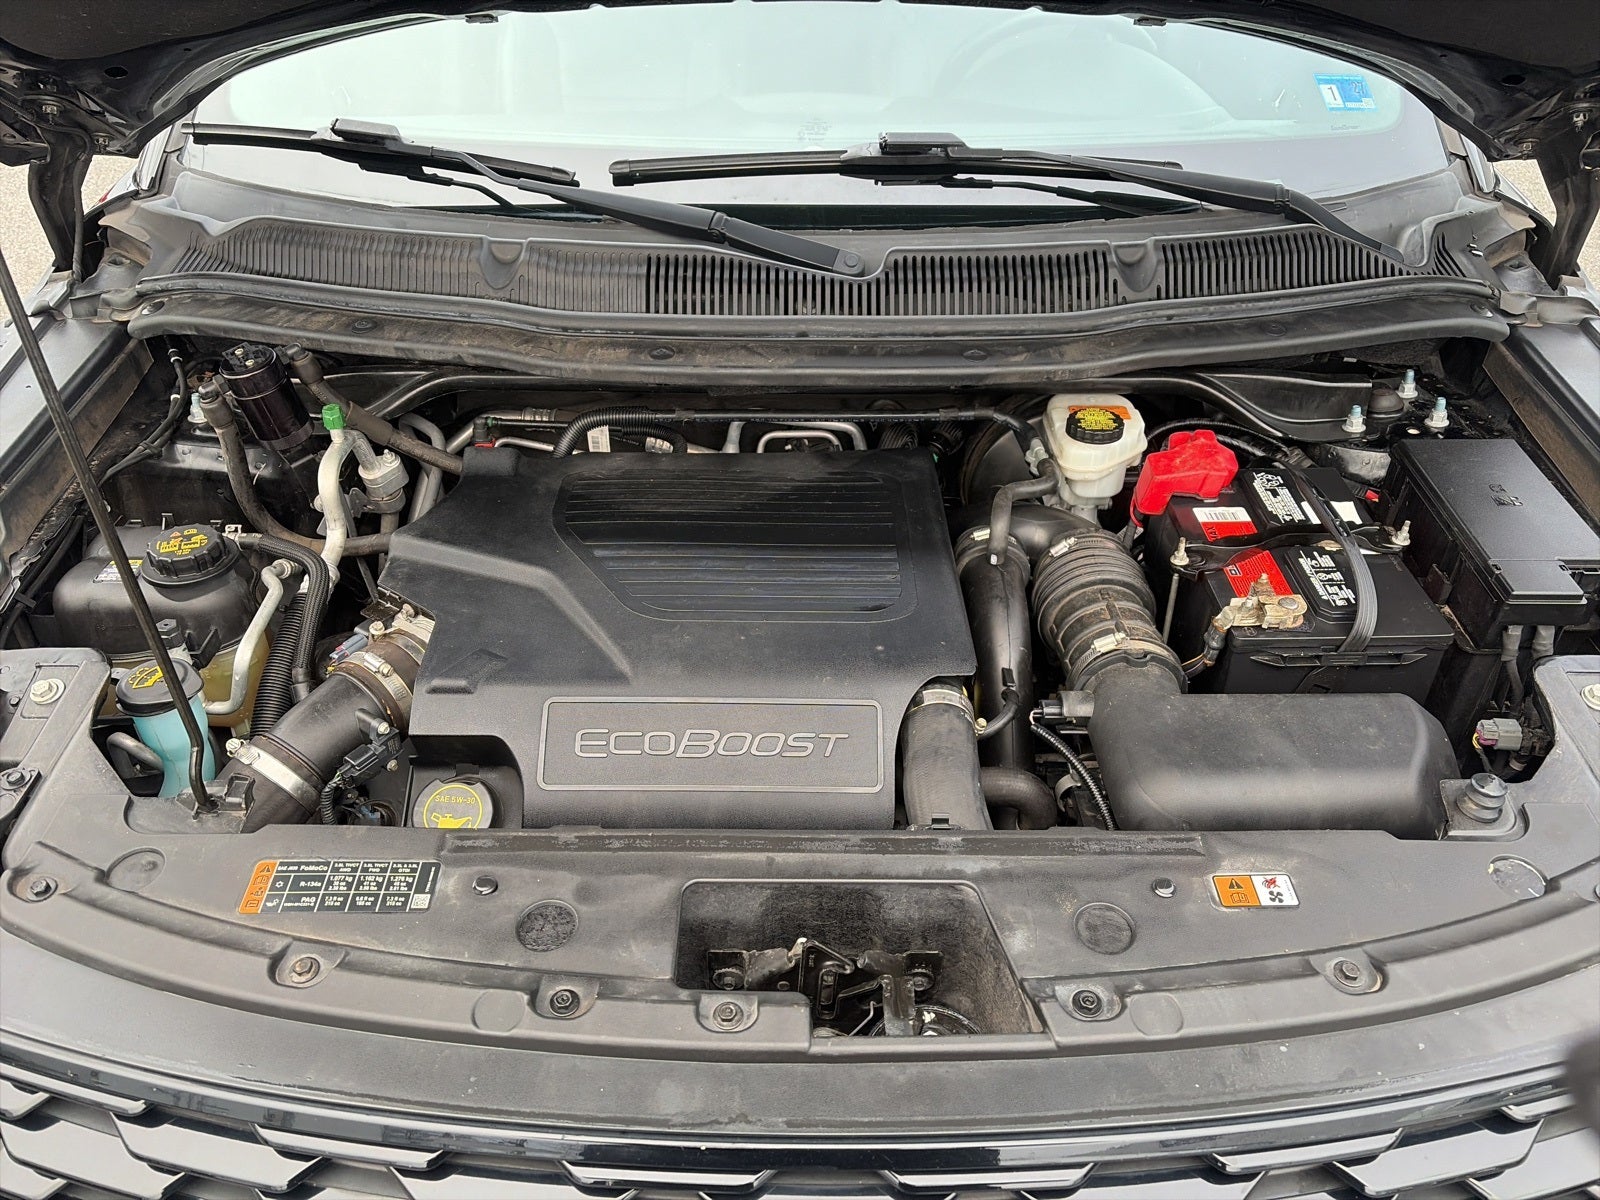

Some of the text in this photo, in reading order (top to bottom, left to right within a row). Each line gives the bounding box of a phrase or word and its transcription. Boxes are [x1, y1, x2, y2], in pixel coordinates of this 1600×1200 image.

[1327, 86, 1337, 101] 1
[435, 795, 476, 804] SAE 5W-30
